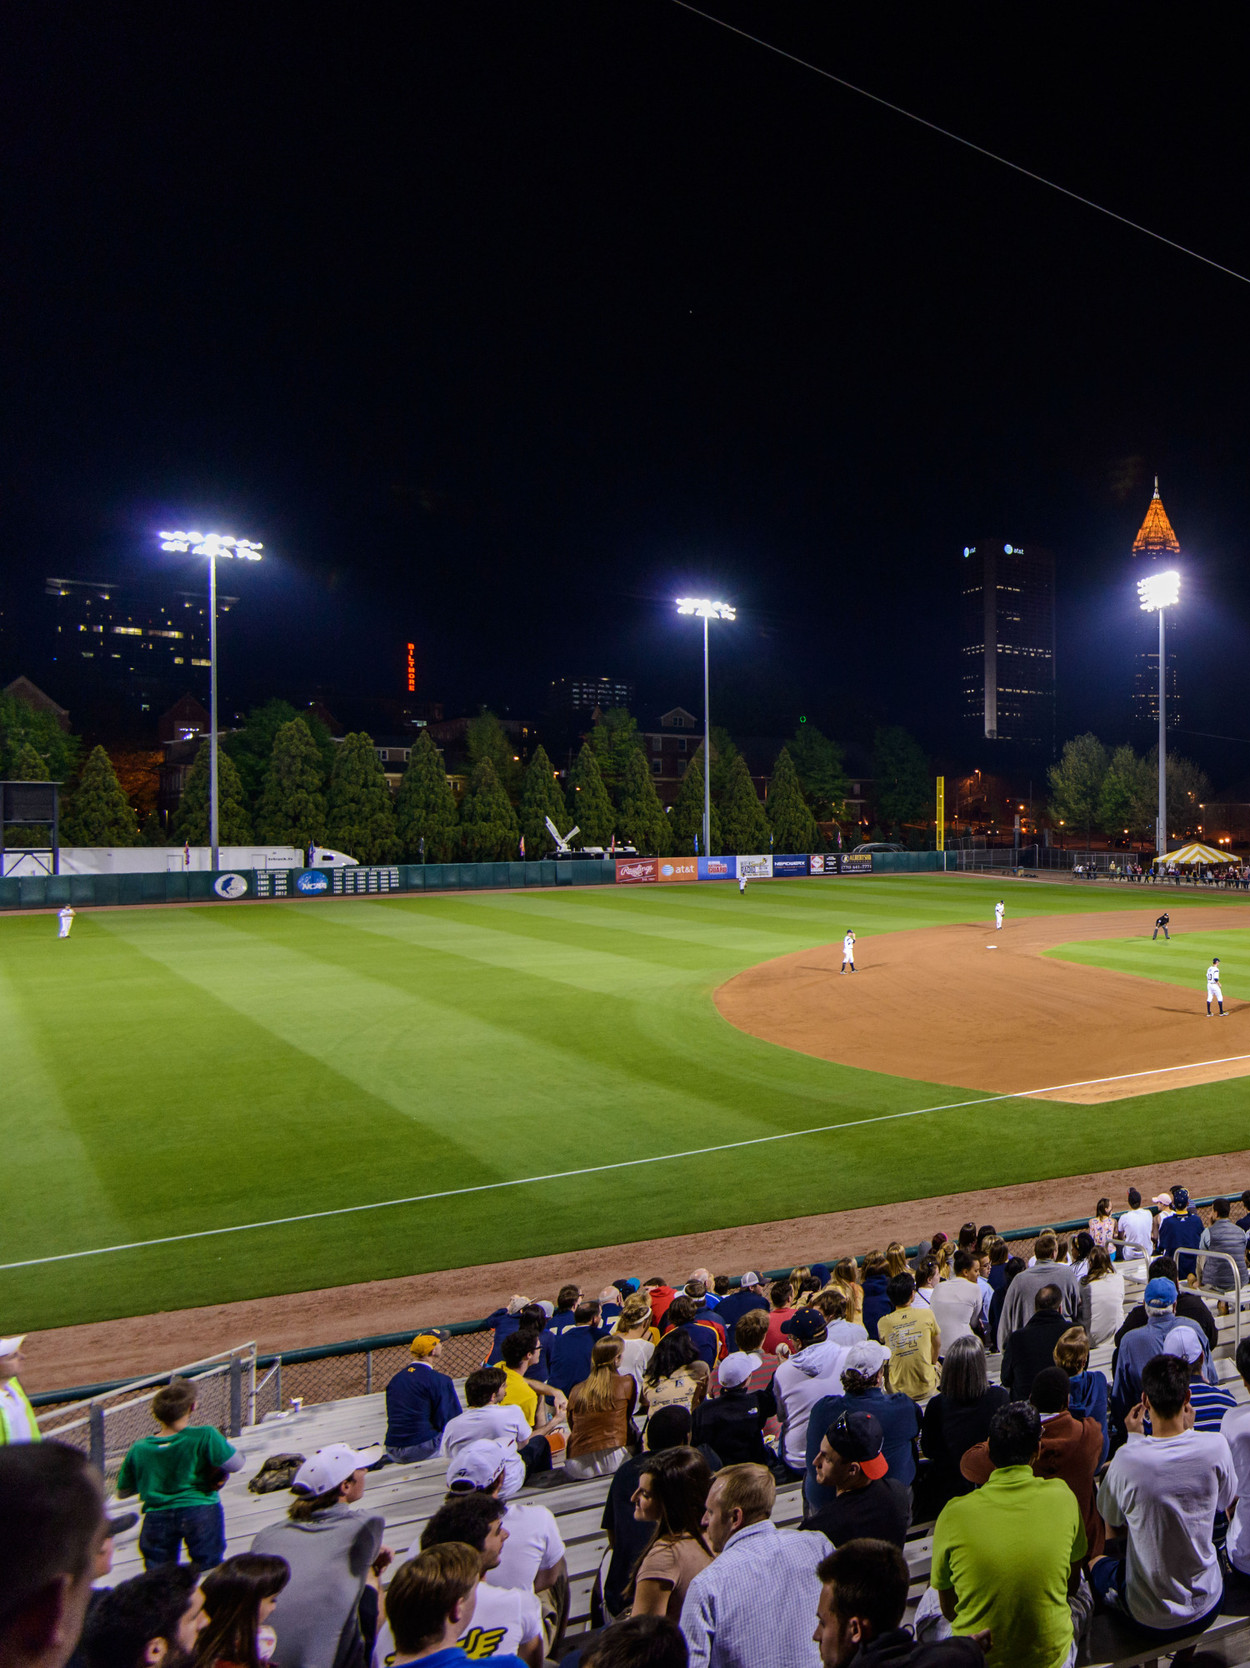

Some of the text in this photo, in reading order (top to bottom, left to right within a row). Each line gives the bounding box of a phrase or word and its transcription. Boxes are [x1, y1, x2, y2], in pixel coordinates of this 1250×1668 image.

[407, 643, 415, 691] BILTMORE
[620, 864, 654, 878] Rawlings
[675, 865, 695, 874] at&t
[302, 882, 327, 890] NCAA
